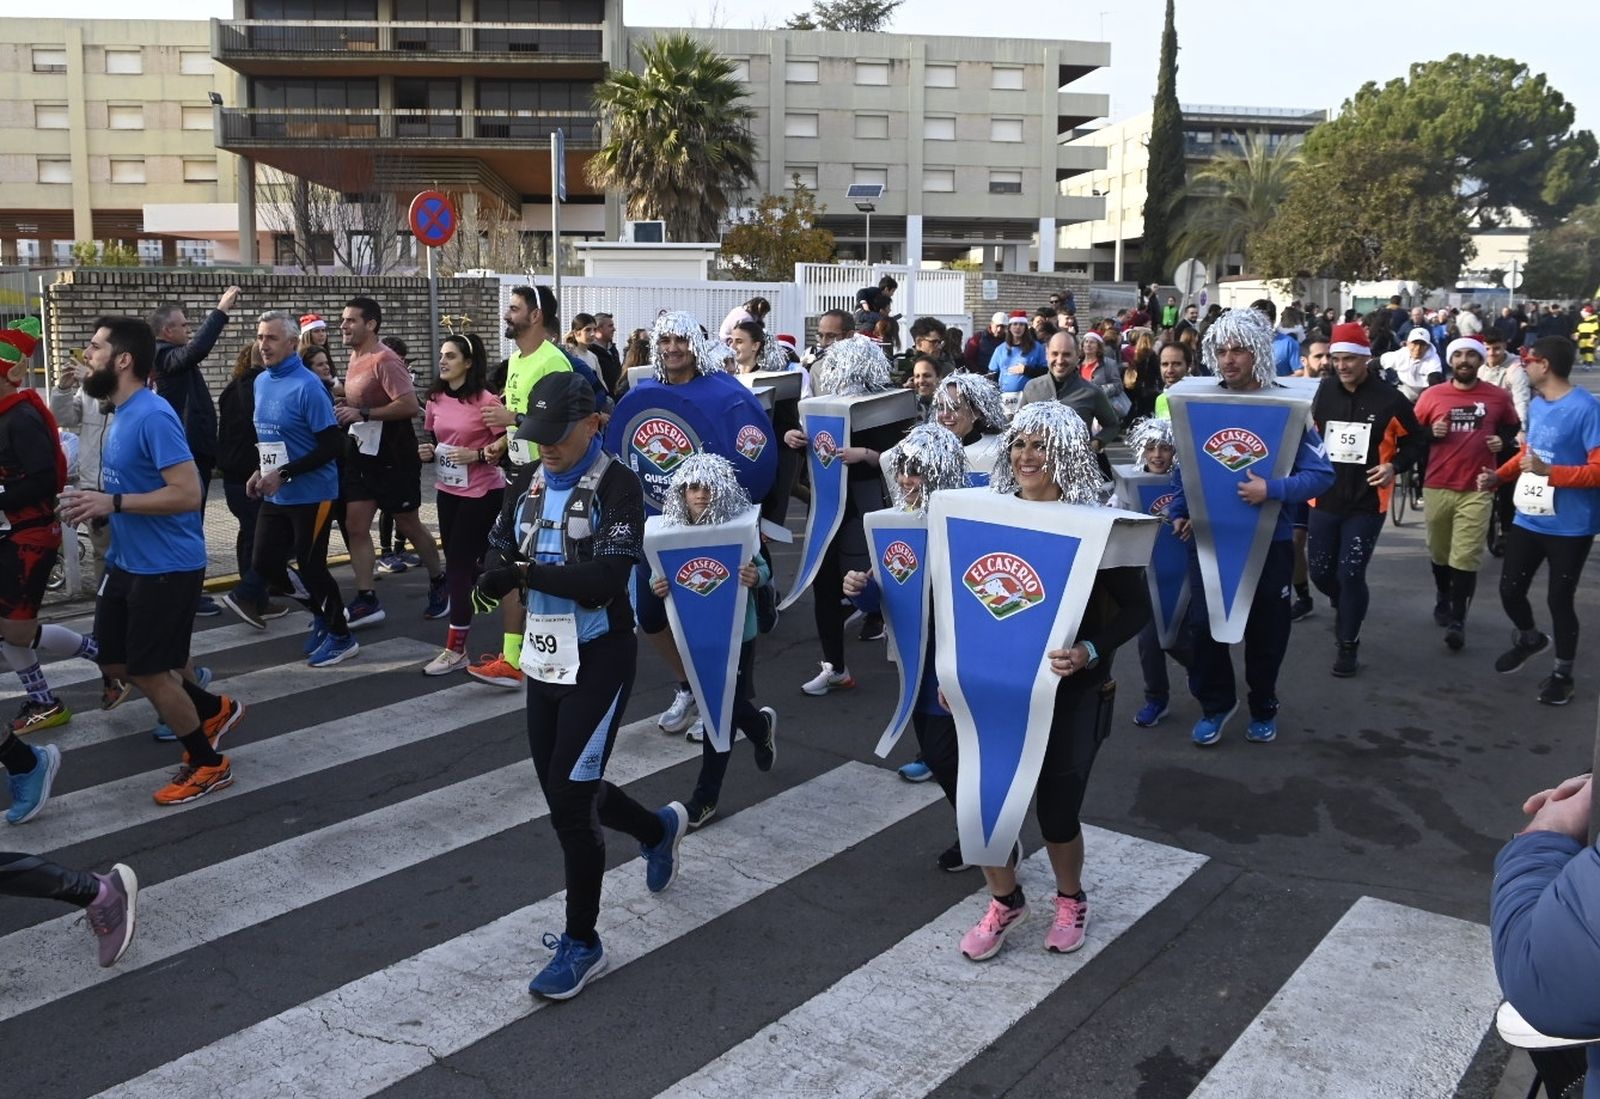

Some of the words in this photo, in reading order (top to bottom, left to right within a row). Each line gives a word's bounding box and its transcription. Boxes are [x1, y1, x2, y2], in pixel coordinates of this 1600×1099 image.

[637, 430, 650, 444] EL
[646, 422, 687, 448] CASERIO
[1209, 436, 1224, 449] EL
[1221, 430, 1263, 452] CASERIO
[1340, 433, 1356, 445] 55
[644, 473, 672, 484] QUESI
[1523, 484, 1544, 498] 342
[680, 565, 692, 579] EL
[688, 560, 724, 575] CASERIO
[970, 564, 989, 581] EL
[986, 557, 1038, 592] CASERIO
